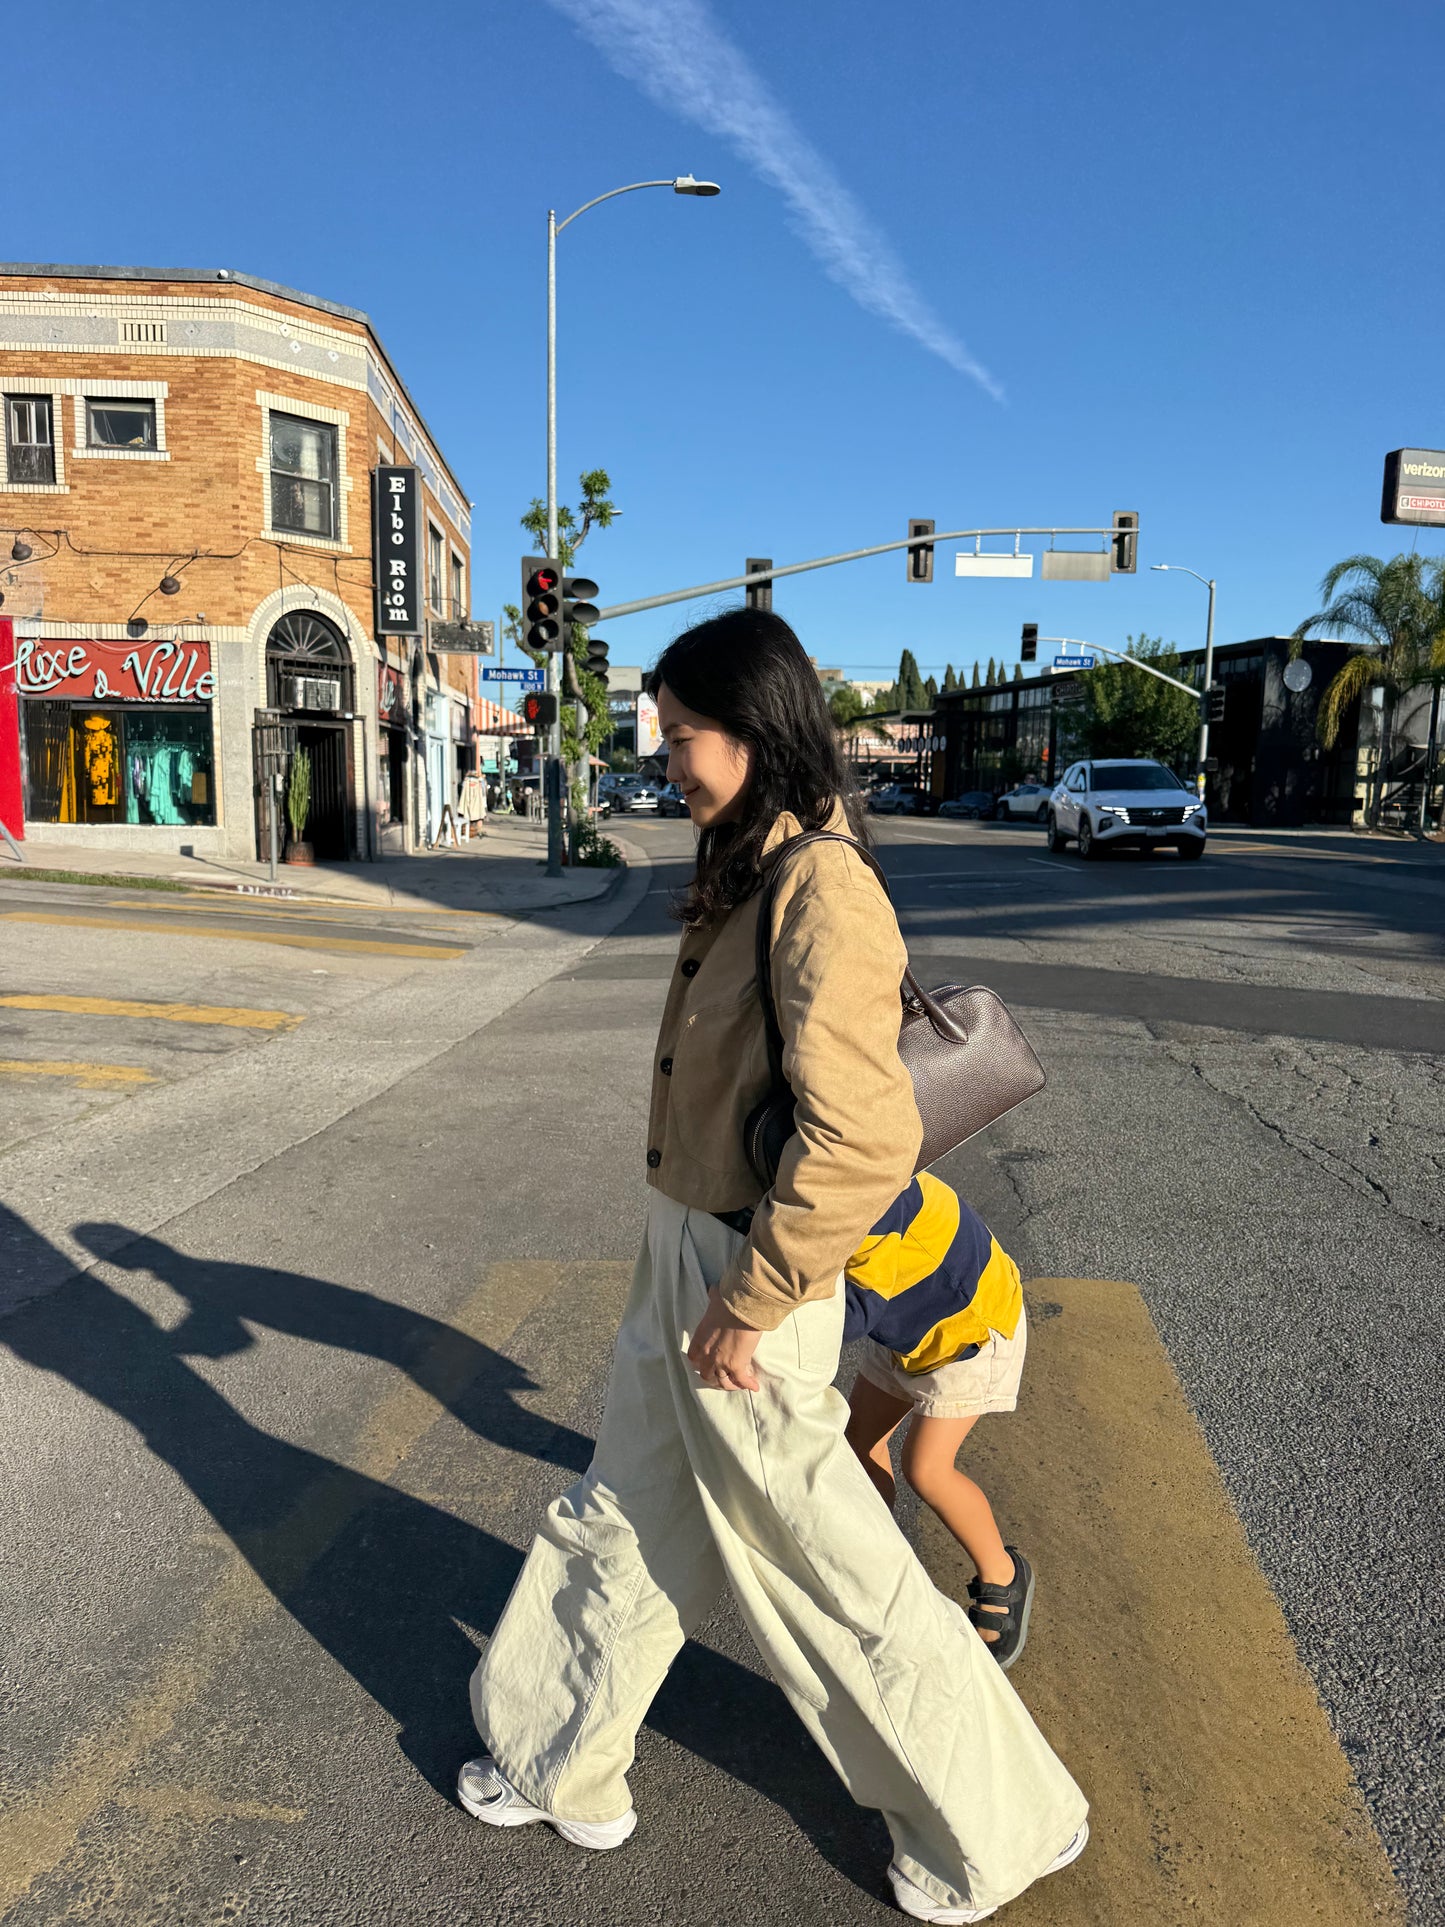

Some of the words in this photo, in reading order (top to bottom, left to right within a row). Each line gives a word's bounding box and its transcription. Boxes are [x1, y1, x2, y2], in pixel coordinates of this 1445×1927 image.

[389, 477, 405, 545] Elbo
[1411, 499, 1445, 508] CHIPOTL
[389, 560, 409, 621] Room
[0, 640, 92, 692] Luxe
[120, 642, 219, 699] Ville
[488, 669, 524, 680] Mohawk
[528, 670, 538, 680] St
[1056, 658, 1081, 666] Mohawk
[1083, 658, 1091, 666] St
